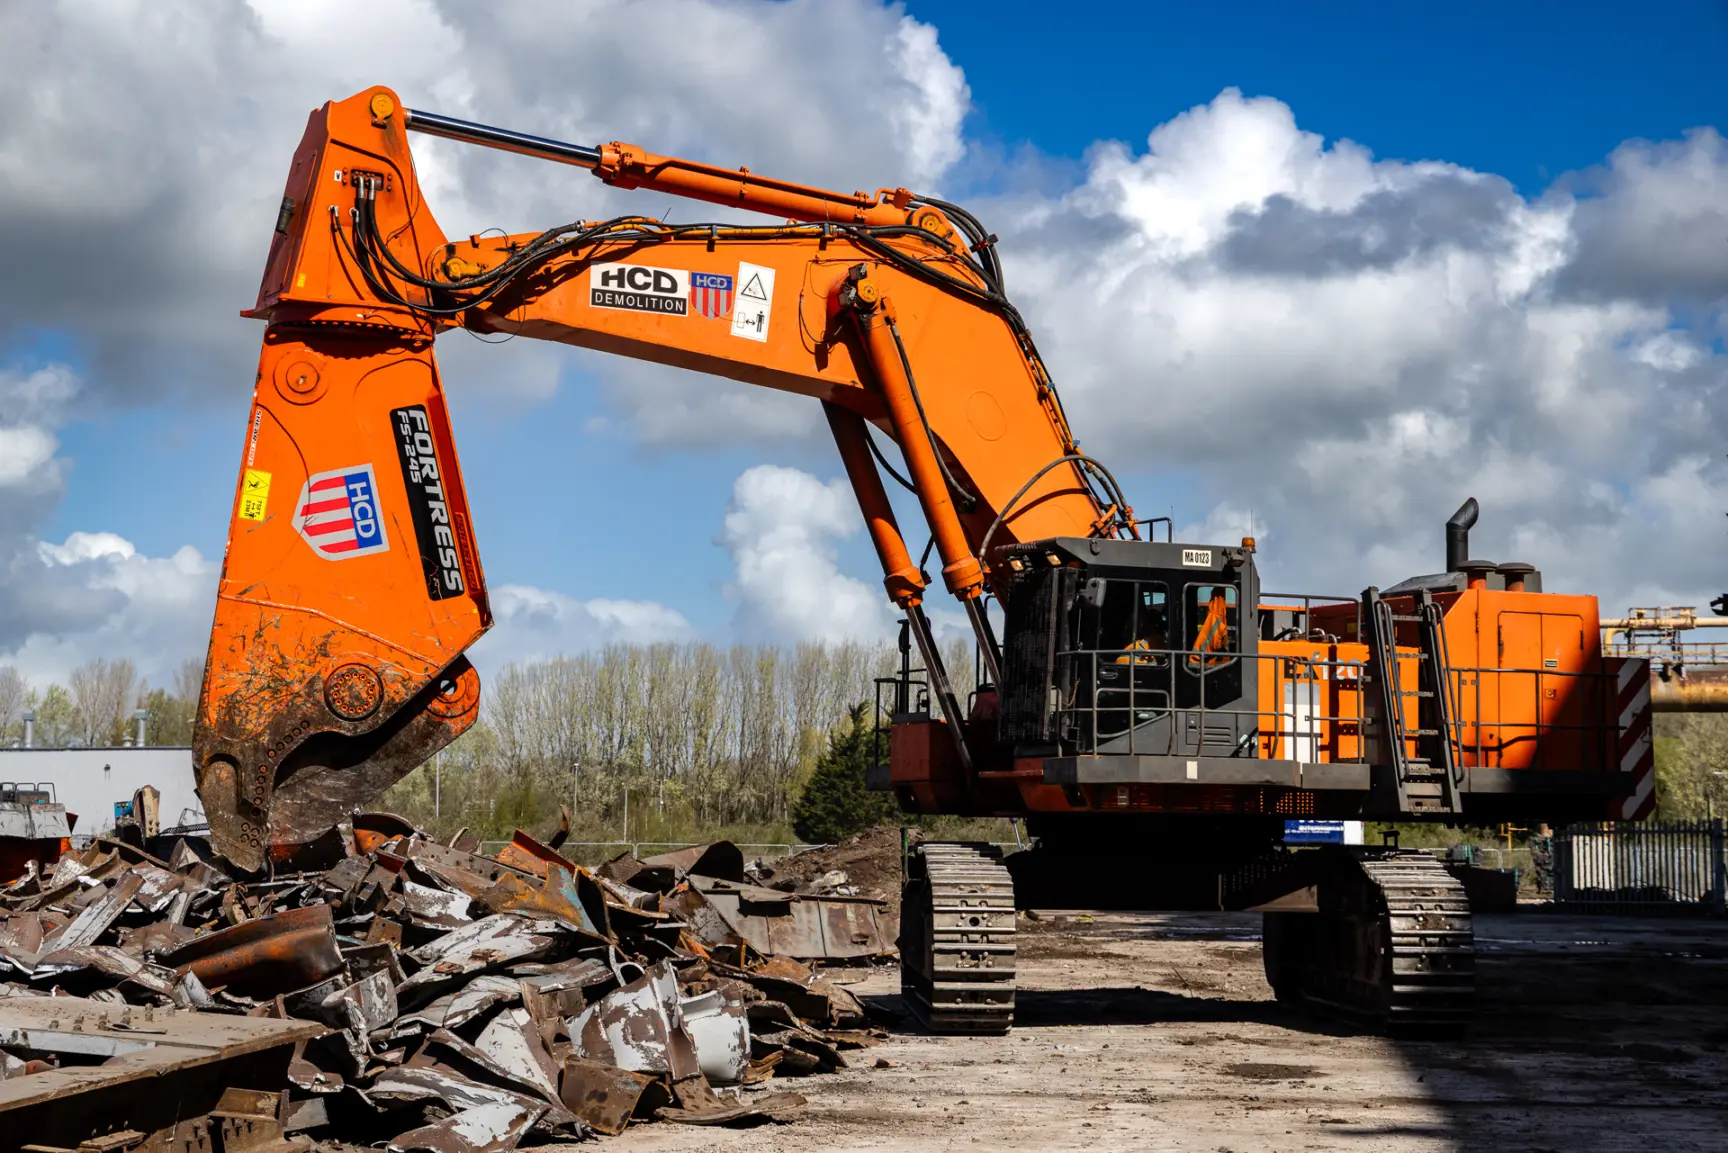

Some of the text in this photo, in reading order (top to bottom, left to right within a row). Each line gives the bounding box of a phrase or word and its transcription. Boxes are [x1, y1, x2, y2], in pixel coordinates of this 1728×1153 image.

[601, 266, 678, 294] HCD
[696, 275, 727, 289] HCD
[595, 292, 684, 312] DEMOLITION
[397, 410, 422, 484] FS-245
[348, 481, 376, 538] HCD
[408, 409, 464, 591] FORTRESS
[1184, 551, 1210, 564] MA 0123
